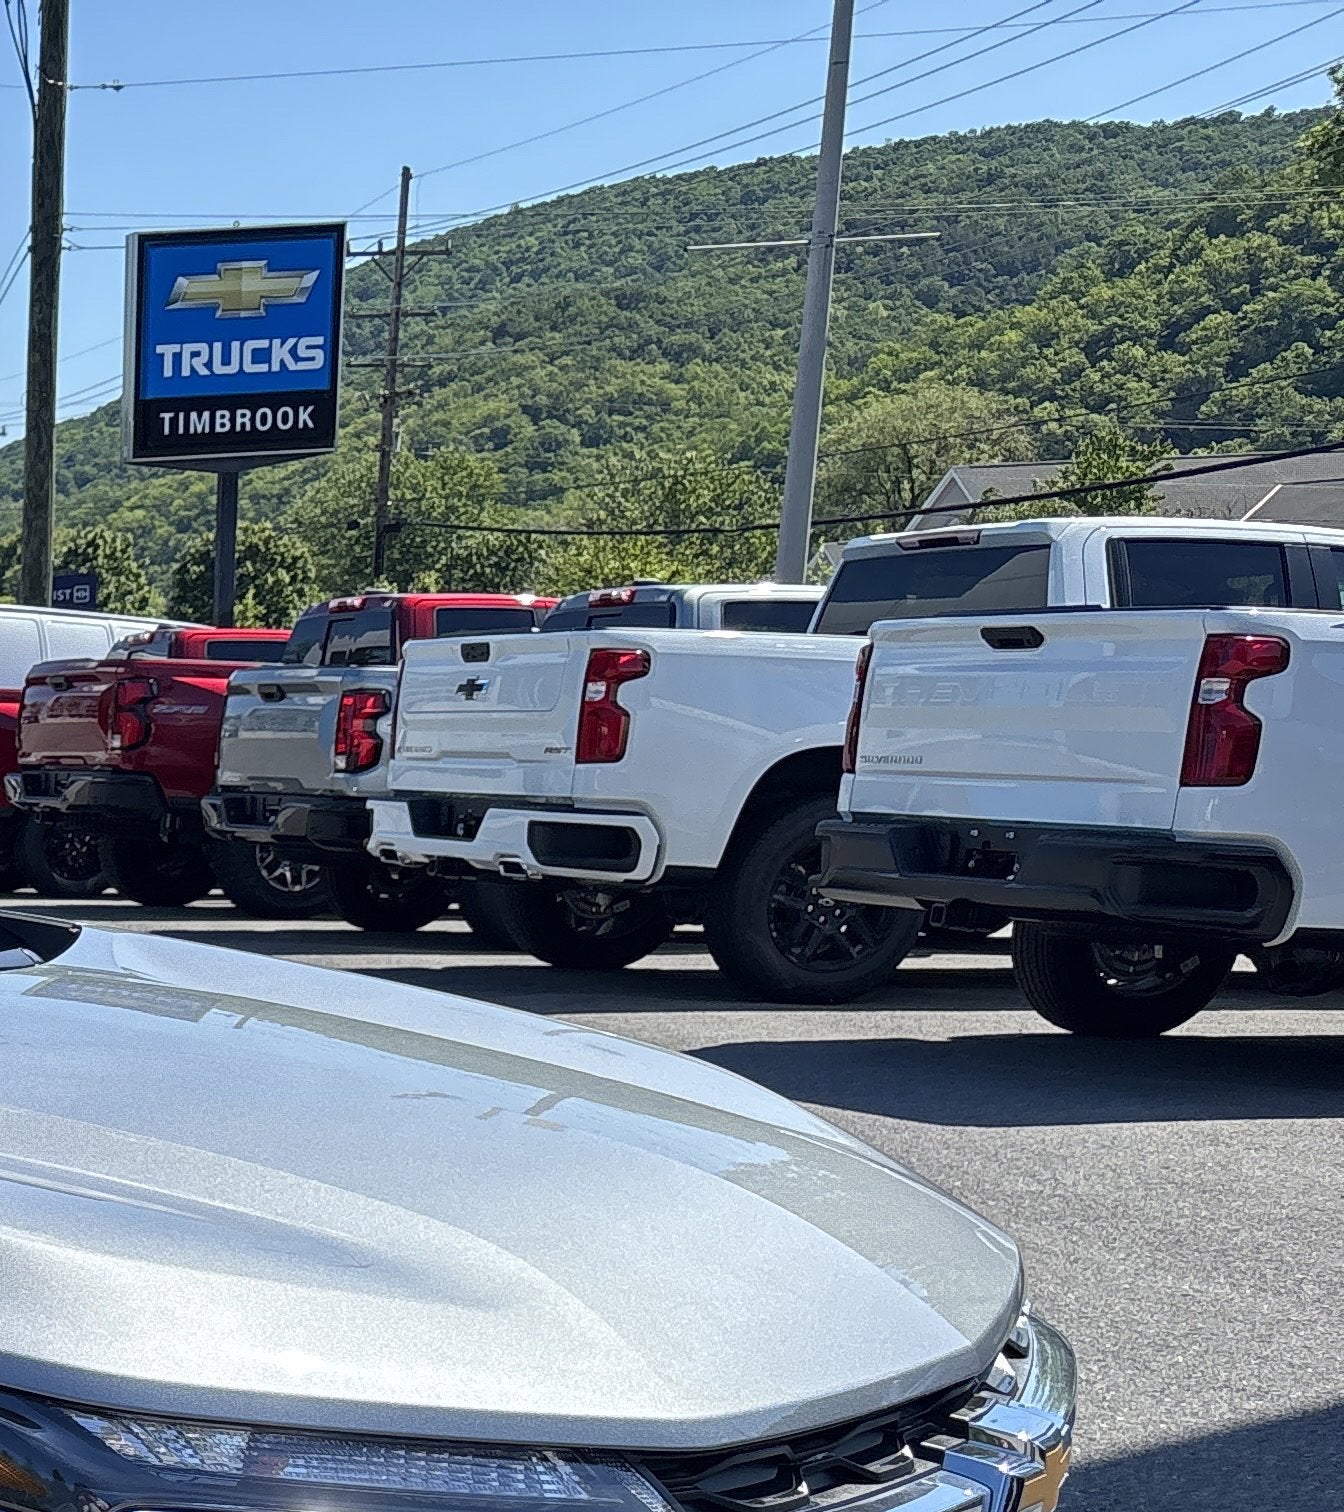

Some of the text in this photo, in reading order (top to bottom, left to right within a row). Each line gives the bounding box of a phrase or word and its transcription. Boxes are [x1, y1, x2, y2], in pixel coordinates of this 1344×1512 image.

[156, 336, 325, 378] TRUCKS
[160, 405, 315, 435] TIMBROOK
[53, 588, 72, 601] IST
